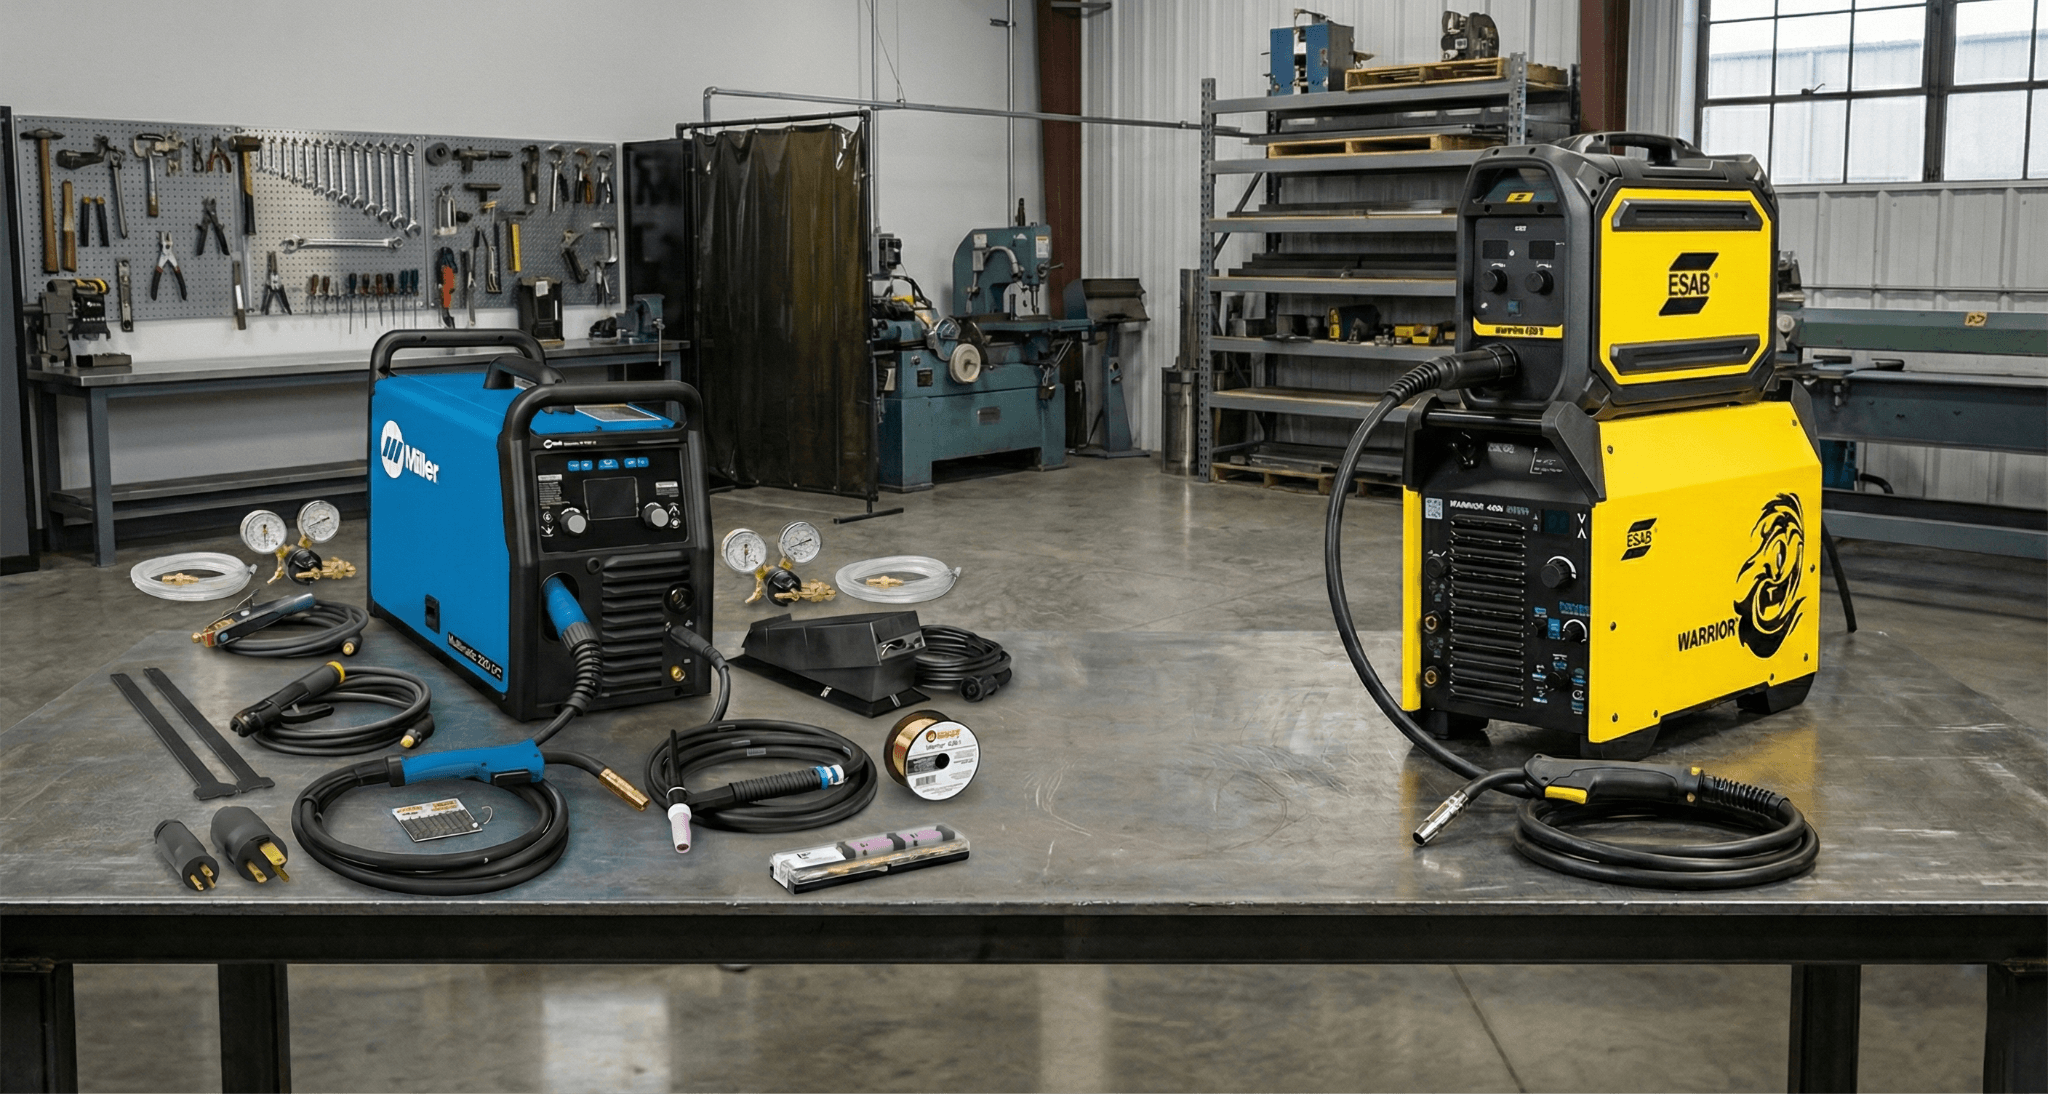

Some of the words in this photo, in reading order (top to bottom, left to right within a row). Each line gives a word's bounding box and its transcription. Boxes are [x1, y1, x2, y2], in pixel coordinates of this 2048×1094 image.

[1668, 273, 1710, 296] ESAB
[404, 444, 440, 484] Miller
[1626, 530, 1652, 548] ESAB
[1677, 618, 1736, 652] WARRIOR
